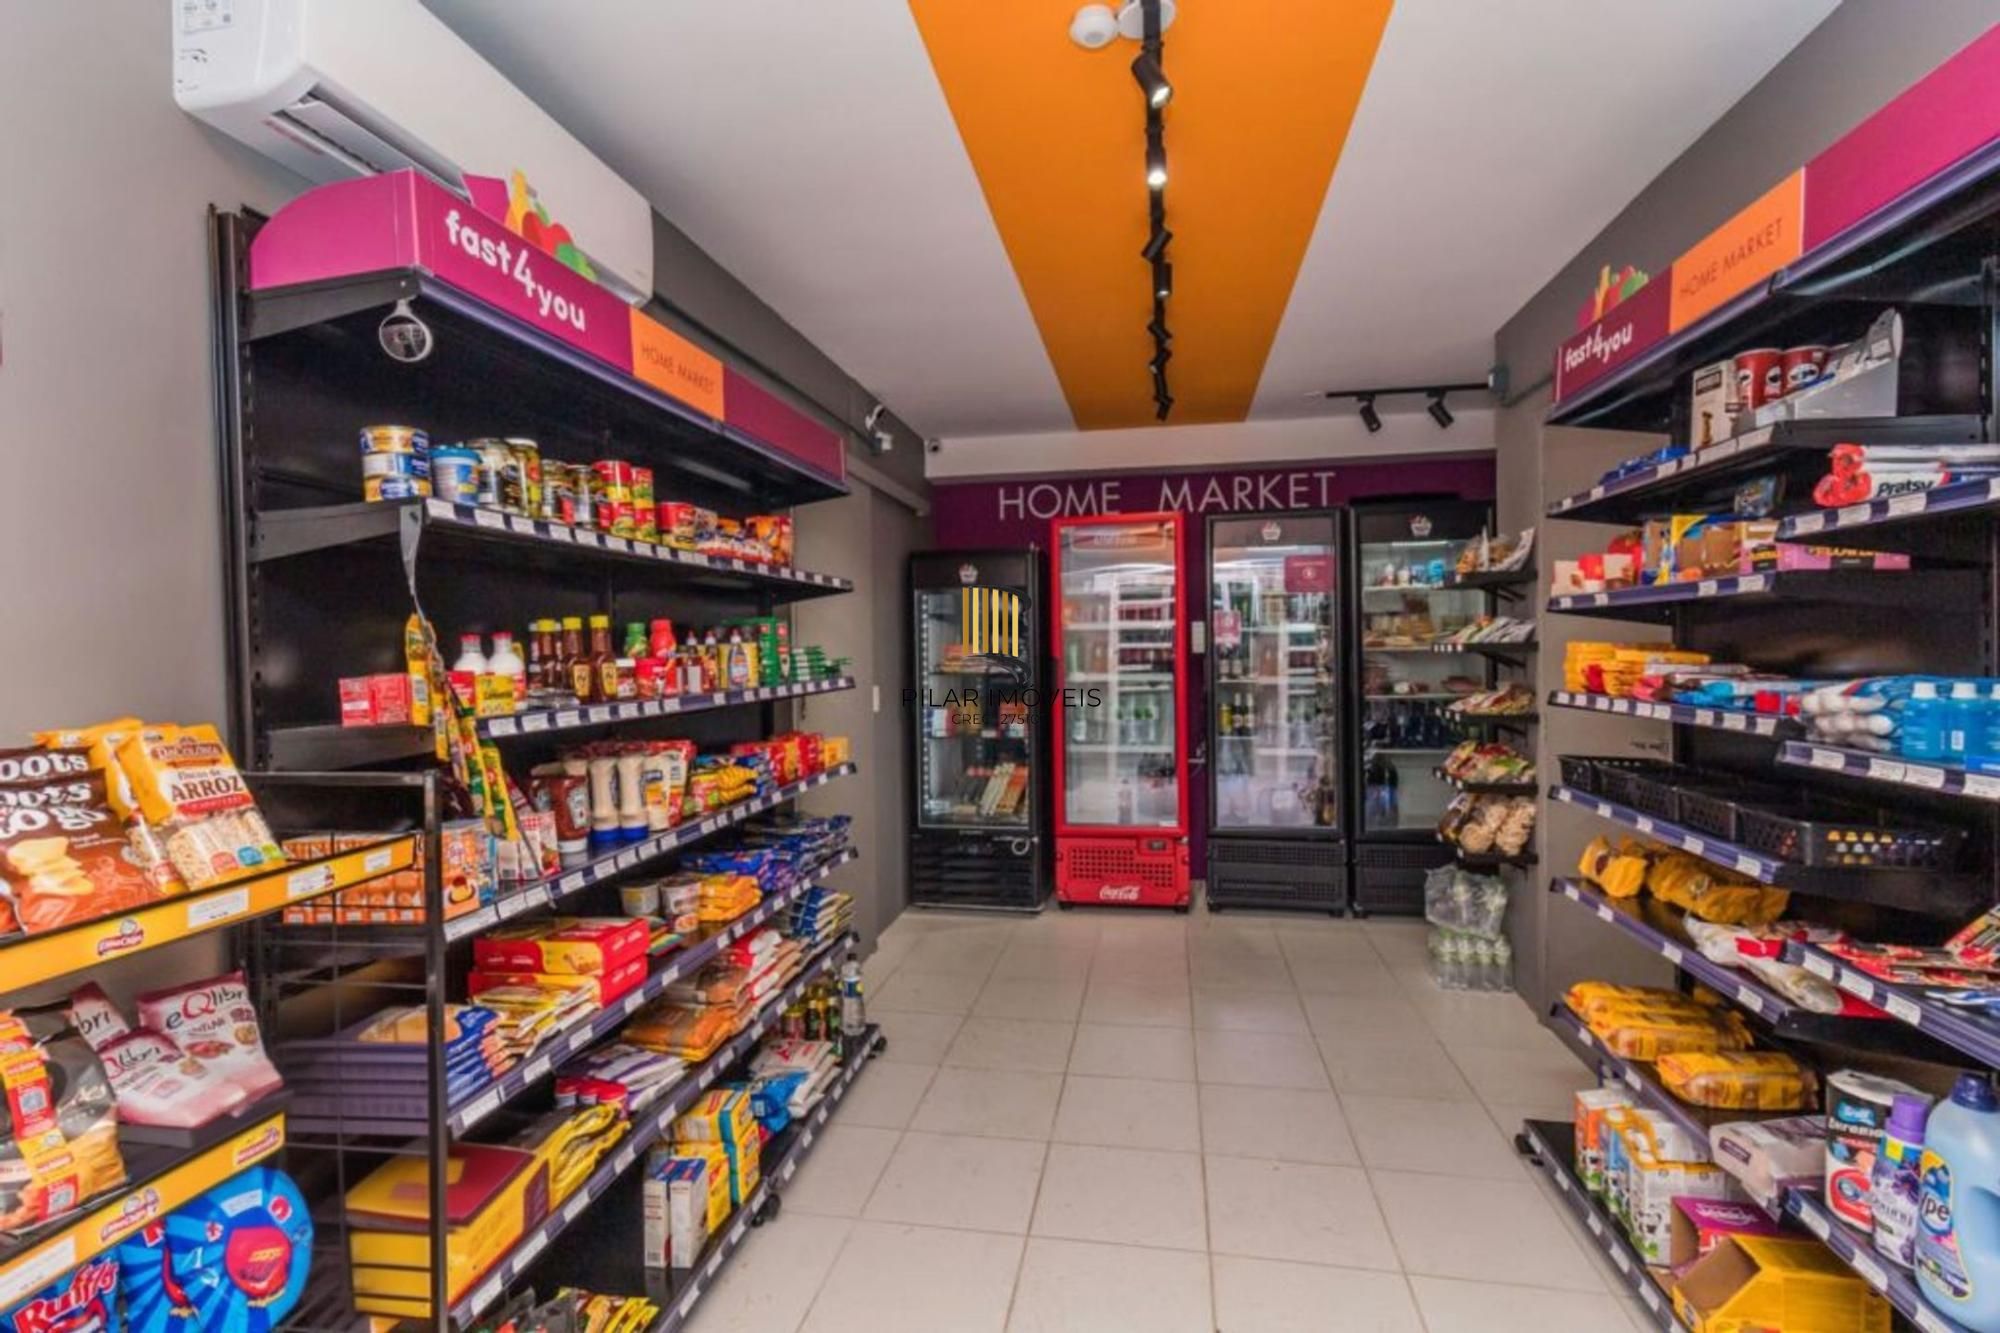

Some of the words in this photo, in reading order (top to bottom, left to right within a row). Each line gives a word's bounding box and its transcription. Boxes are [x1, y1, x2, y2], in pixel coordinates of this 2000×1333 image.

[1680, 261, 1719, 299] HOME
[1722, 217, 1783, 270] MARKET
[640, 341, 674, 376] HOME
[677, 361, 716, 395] MARKET
[998, 481, 1121, 520] HOME
[1157, 471, 1336, 514] MARKET
[171, 775, 244, 803] ARROZ
